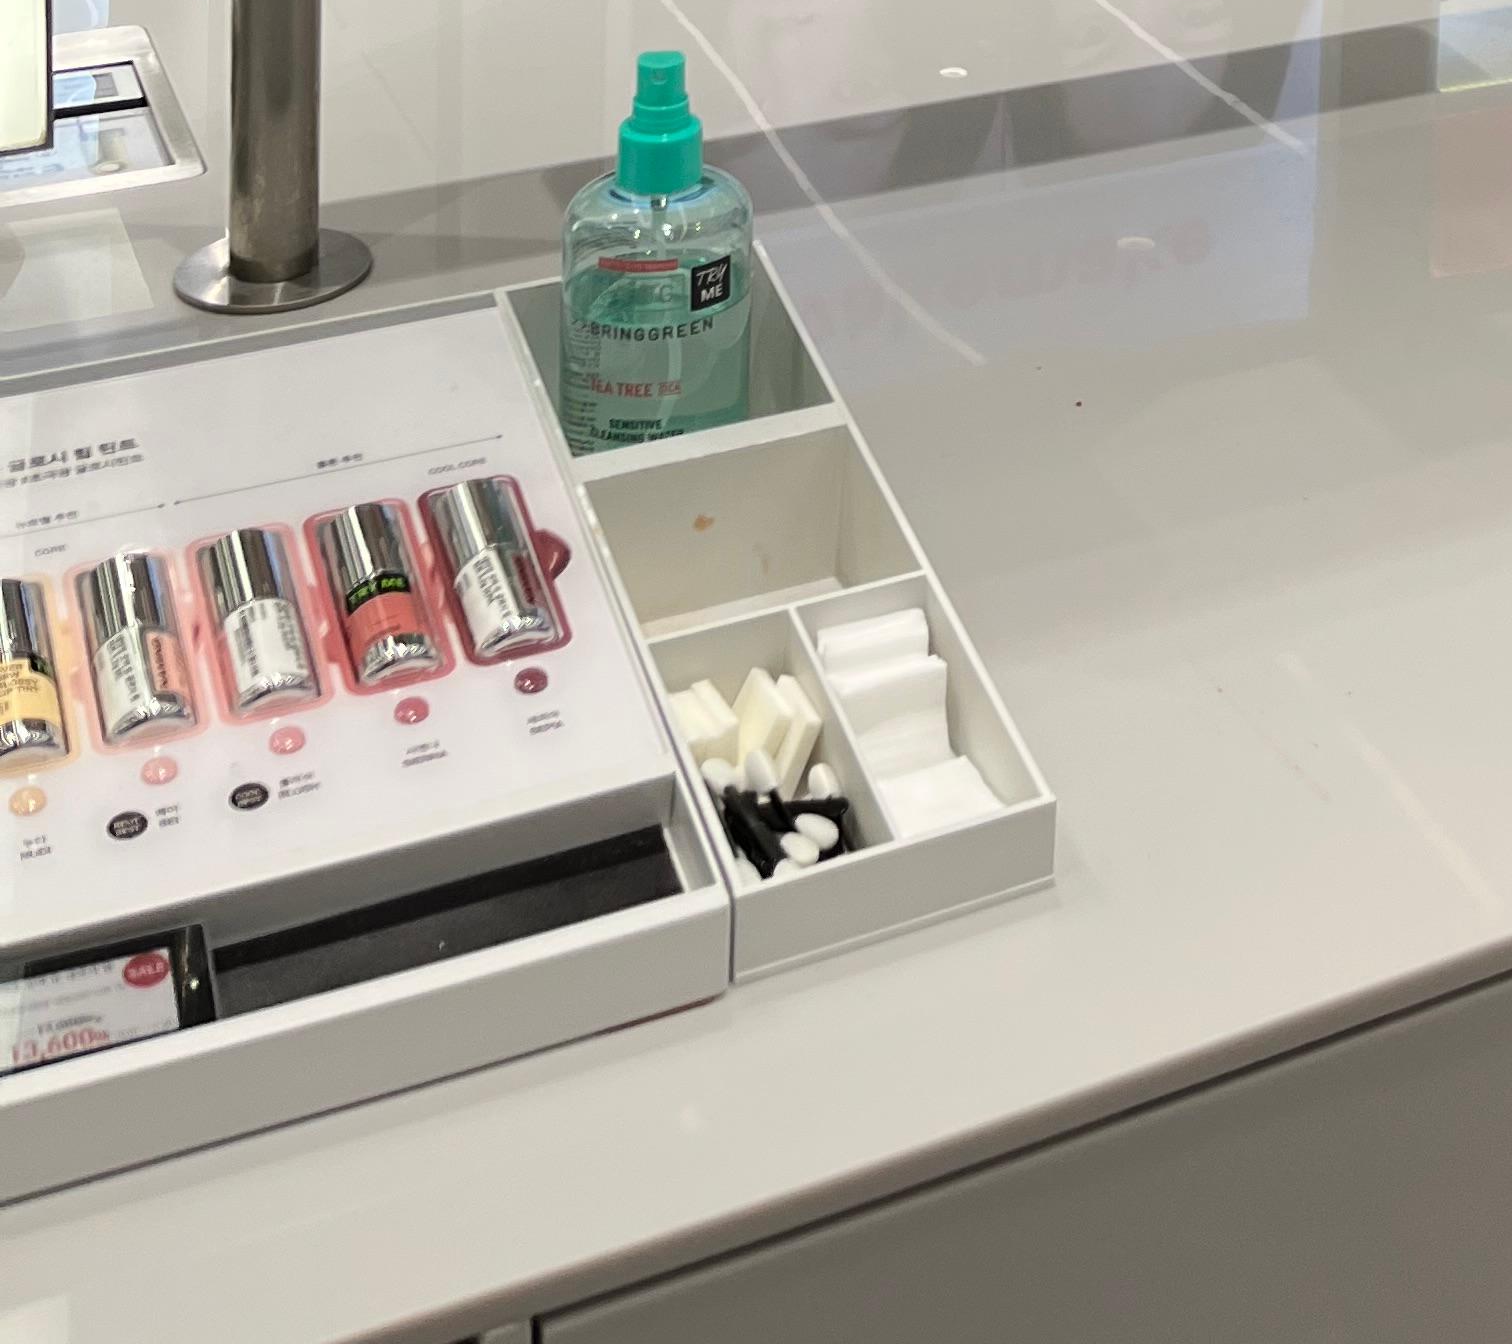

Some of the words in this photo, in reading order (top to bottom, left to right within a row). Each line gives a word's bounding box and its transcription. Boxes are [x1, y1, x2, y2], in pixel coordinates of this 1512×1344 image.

[696, 263, 728, 287] TRY
[700, 284, 724, 303] ME
[590, 317, 714, 342] BRINGGREEN
[616, 382, 654, 398] TREE
